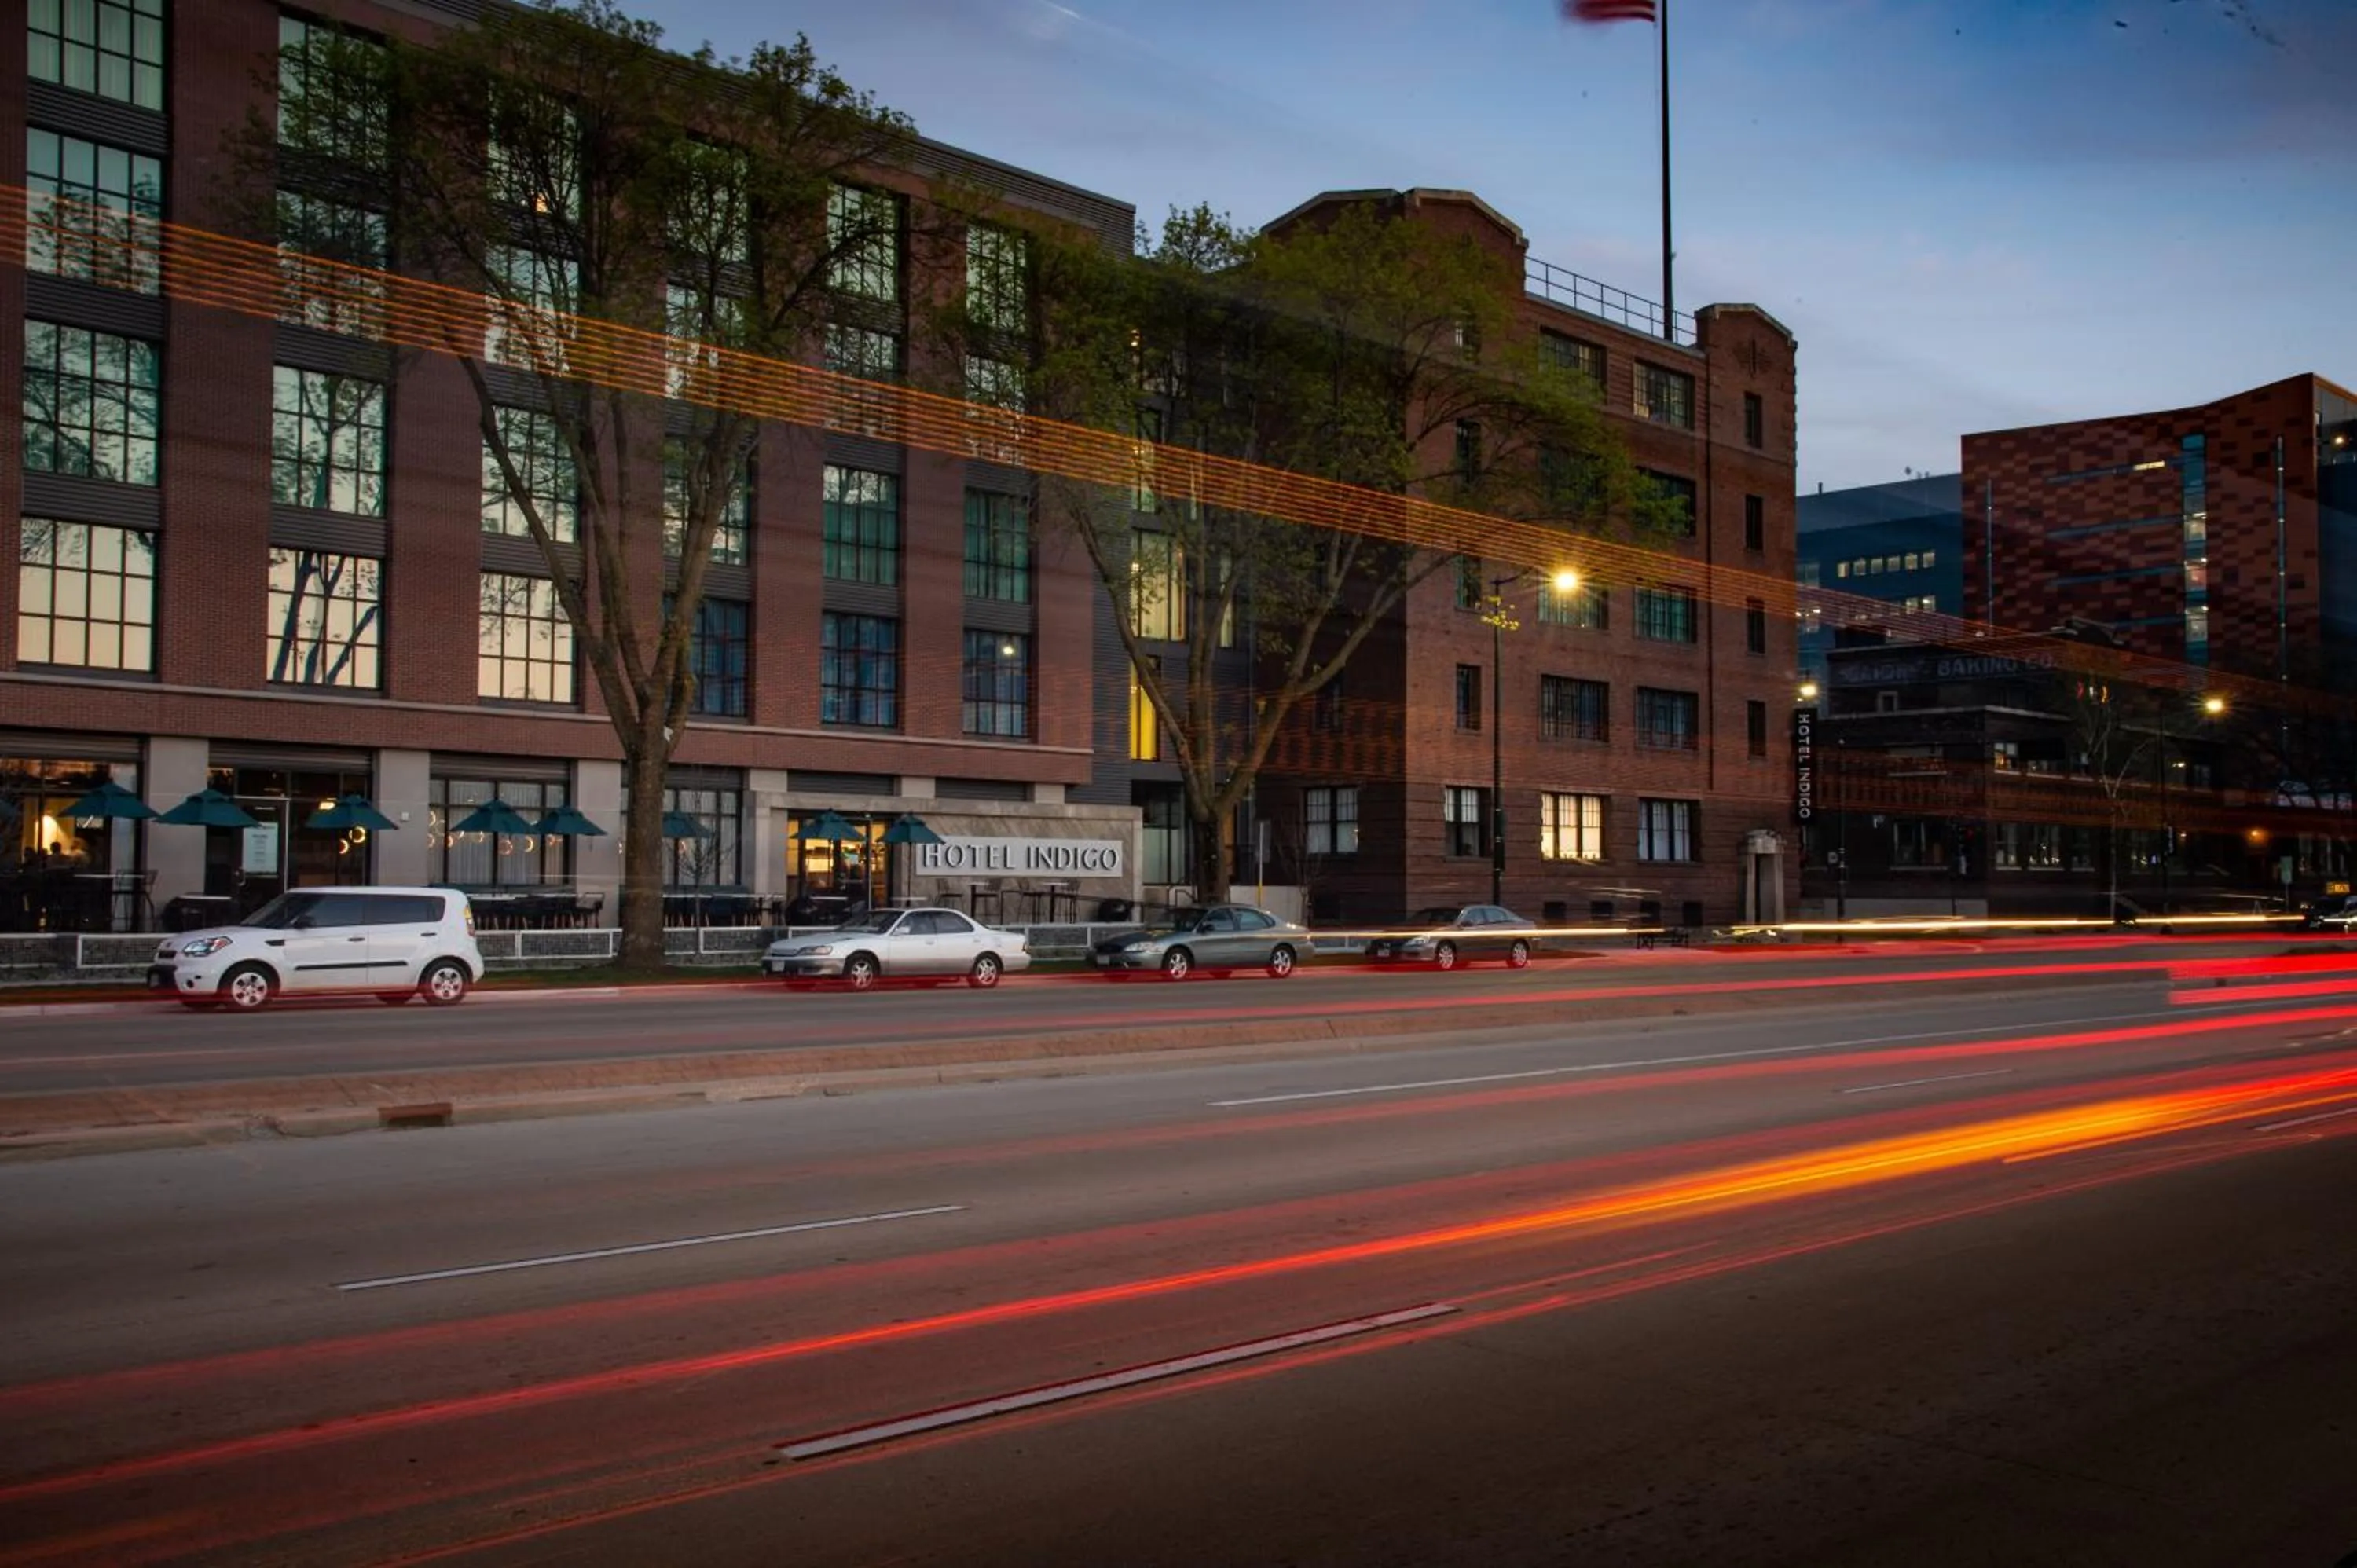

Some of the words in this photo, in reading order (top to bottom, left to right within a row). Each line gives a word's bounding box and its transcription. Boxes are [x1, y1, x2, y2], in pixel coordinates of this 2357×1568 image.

[1798, 714, 1811, 763] HOTEL
[1798, 768, 1811, 819] INDIGO
[922, 844, 1016, 870] HOTEL
[1026, 846, 1120, 871] INDIGO
